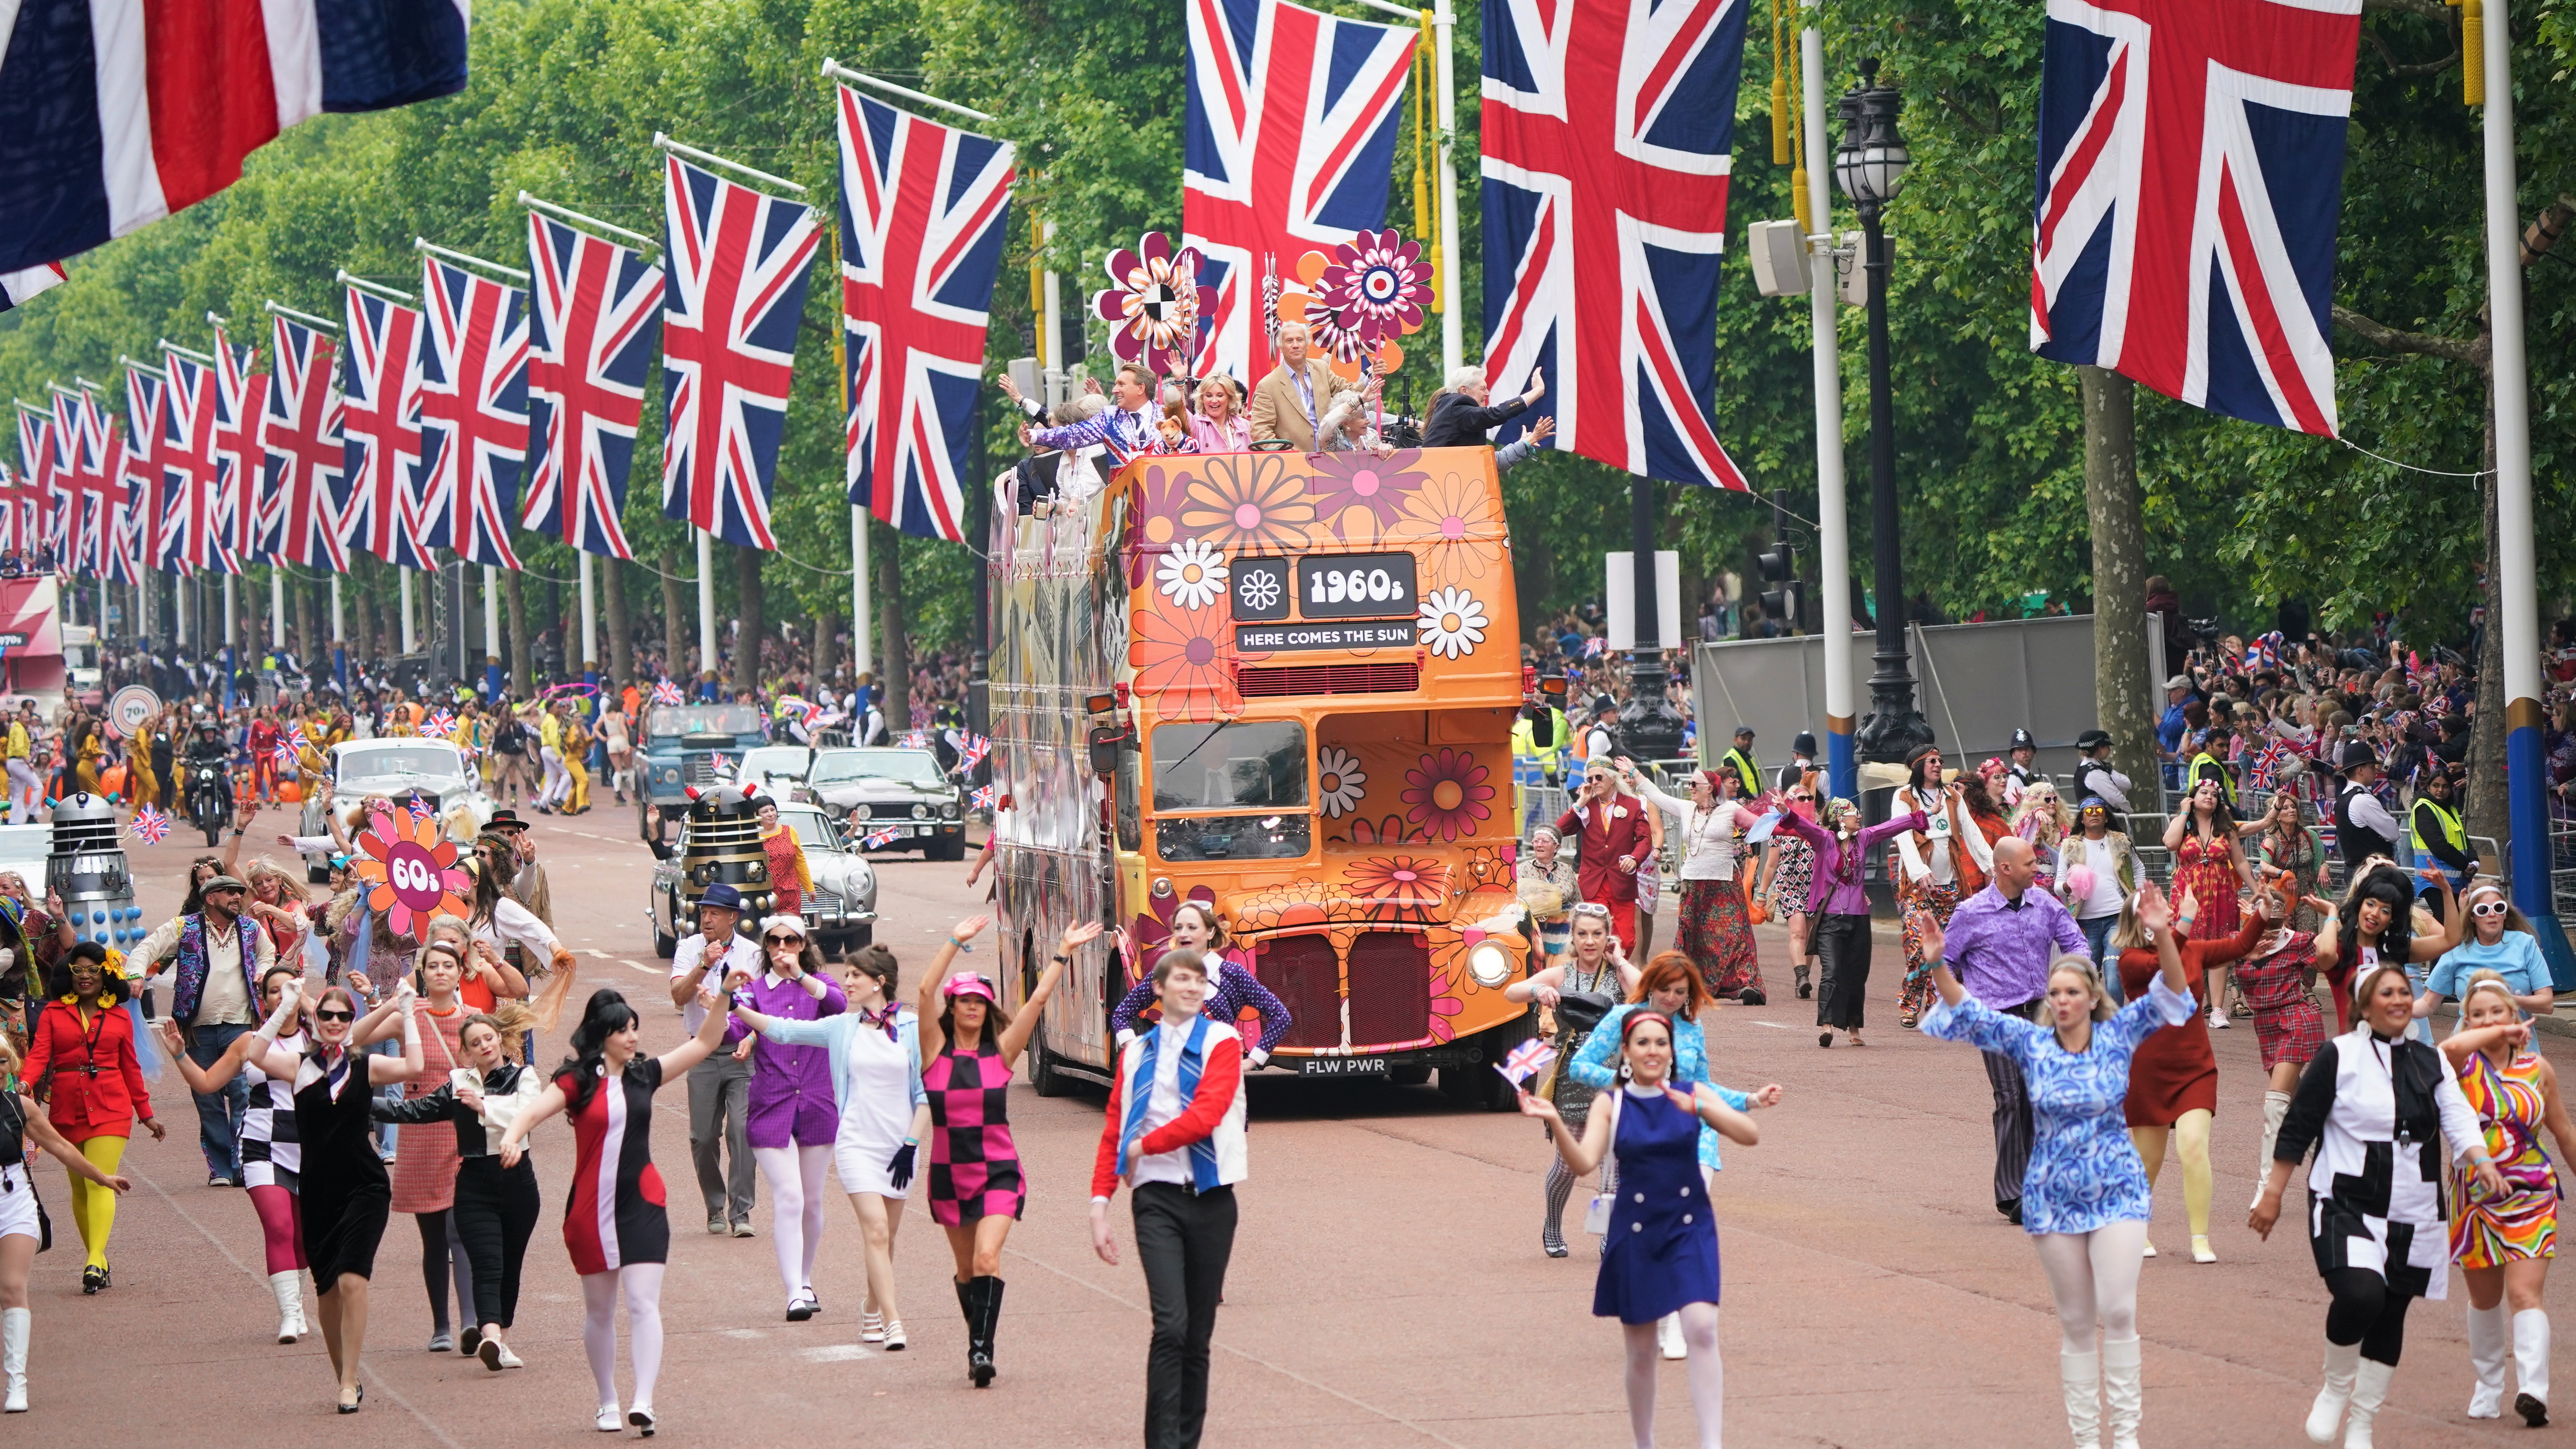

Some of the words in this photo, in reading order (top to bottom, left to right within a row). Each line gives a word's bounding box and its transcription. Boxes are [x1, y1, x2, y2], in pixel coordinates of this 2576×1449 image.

[1311, 569, 1404, 602] 1960s
[1244, 634, 1283, 645] HERE
[1288, 631, 1340, 643] COMES
[1344, 630, 1373, 641] THE
[1378, 629, 1408, 641] SUN
[126, 707, 145, 718] 70s
[393, 857, 439, 892] 60s
[1306, 1061, 1341, 1073] FLW
[1347, 1059, 1384, 1072] PWR
